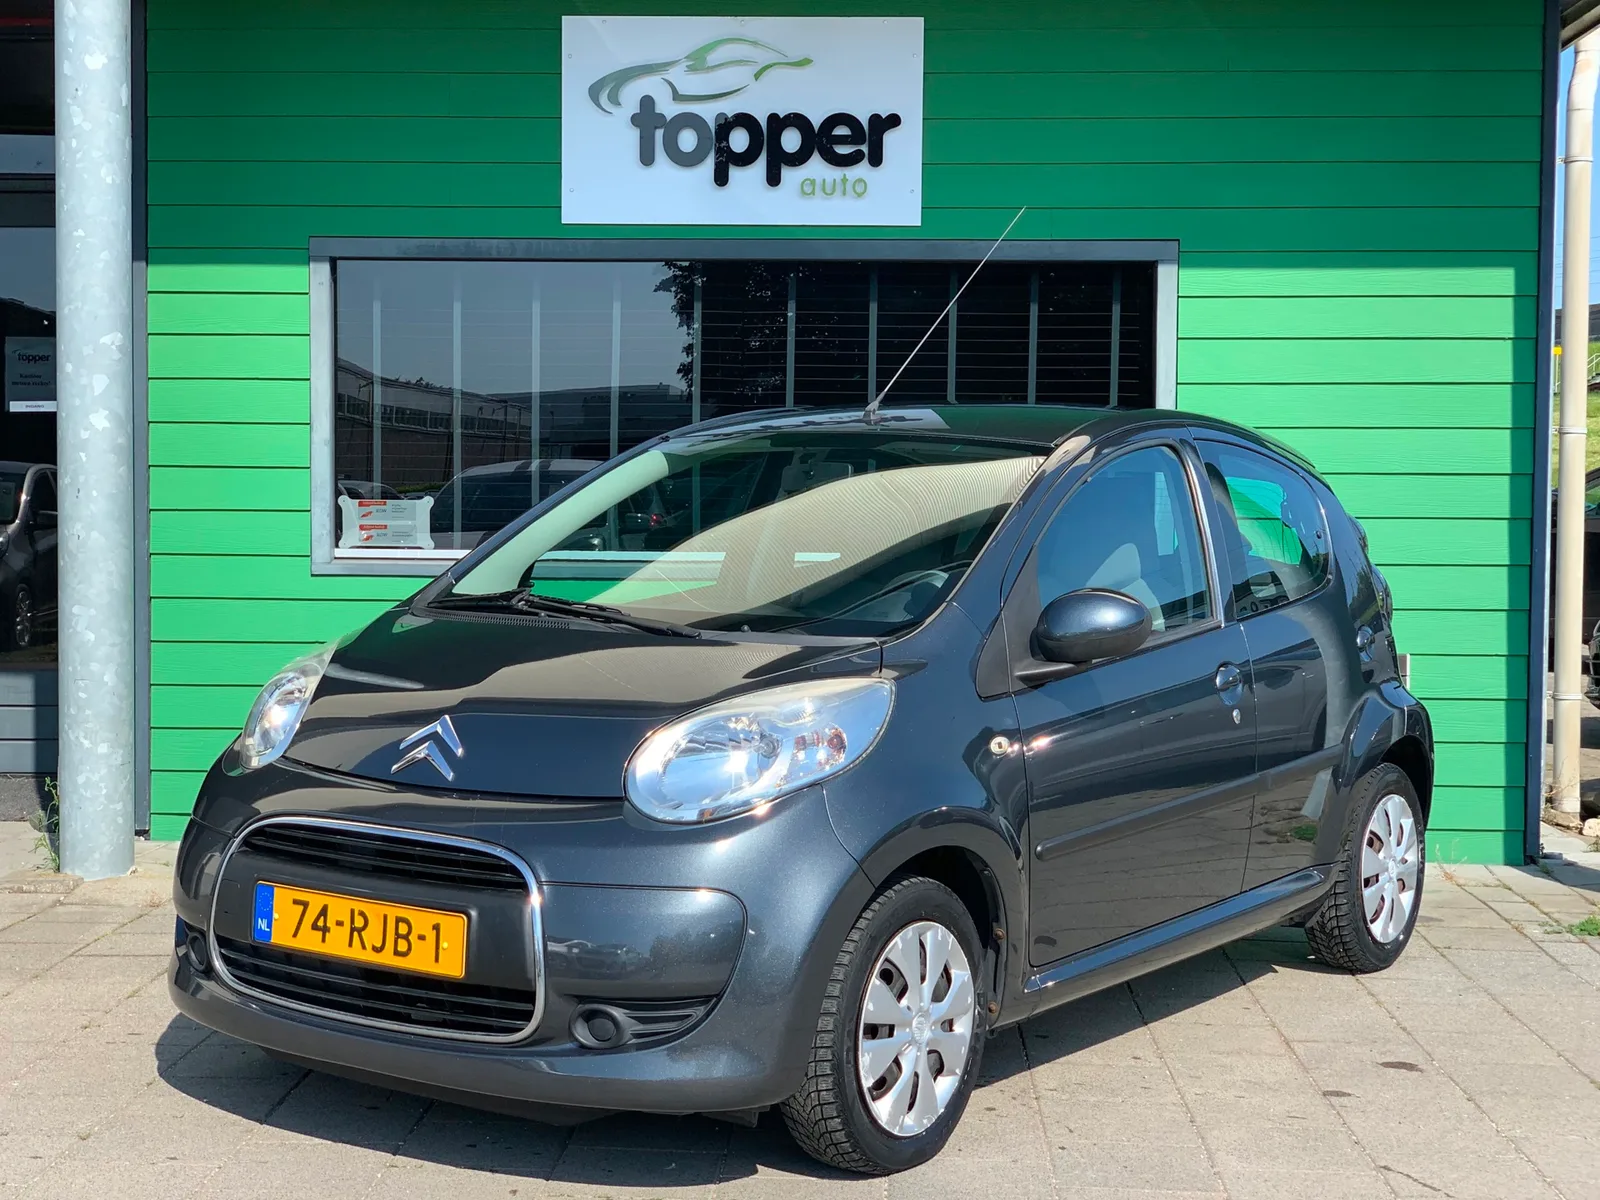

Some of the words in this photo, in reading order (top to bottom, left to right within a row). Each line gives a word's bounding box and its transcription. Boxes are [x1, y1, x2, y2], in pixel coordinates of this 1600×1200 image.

[630, 94, 902, 187] topper
[800, 173, 868, 198] auto
[17, 352, 52, 364] topper
[257, 917, 271, 932] NL
[291, 898, 441, 964] 74-RJB-1
